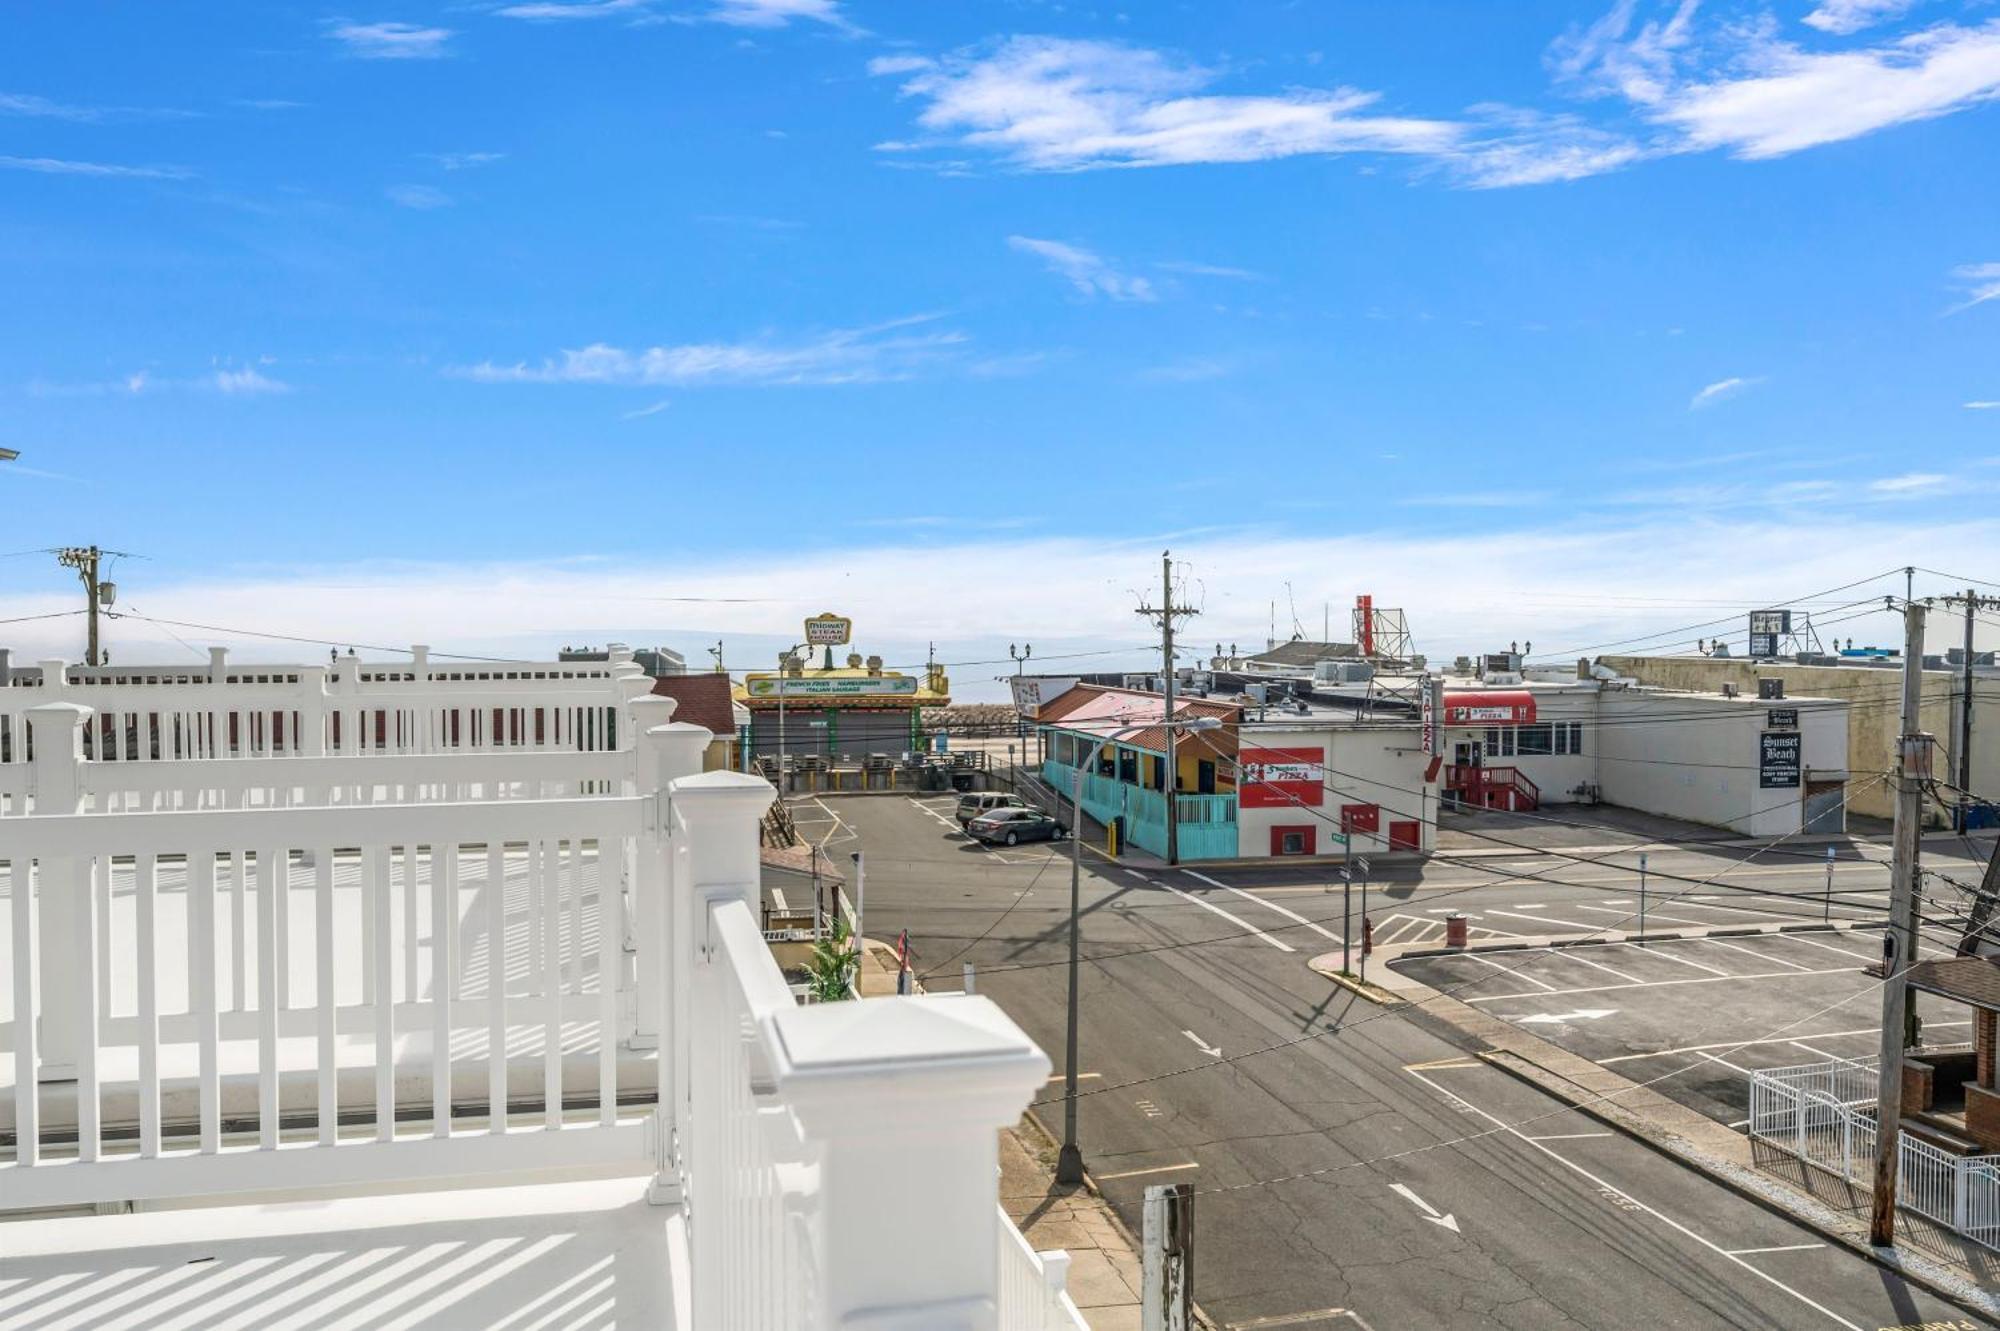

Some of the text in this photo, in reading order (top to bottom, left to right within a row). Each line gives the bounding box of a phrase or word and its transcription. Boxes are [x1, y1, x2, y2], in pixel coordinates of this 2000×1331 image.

[1423, 704, 1432, 754] PIZZA
[1763, 735, 1798, 748] Sunset
[1765, 747, 1796, 761] Beach
[1278, 772, 1309, 780] PIZZA
